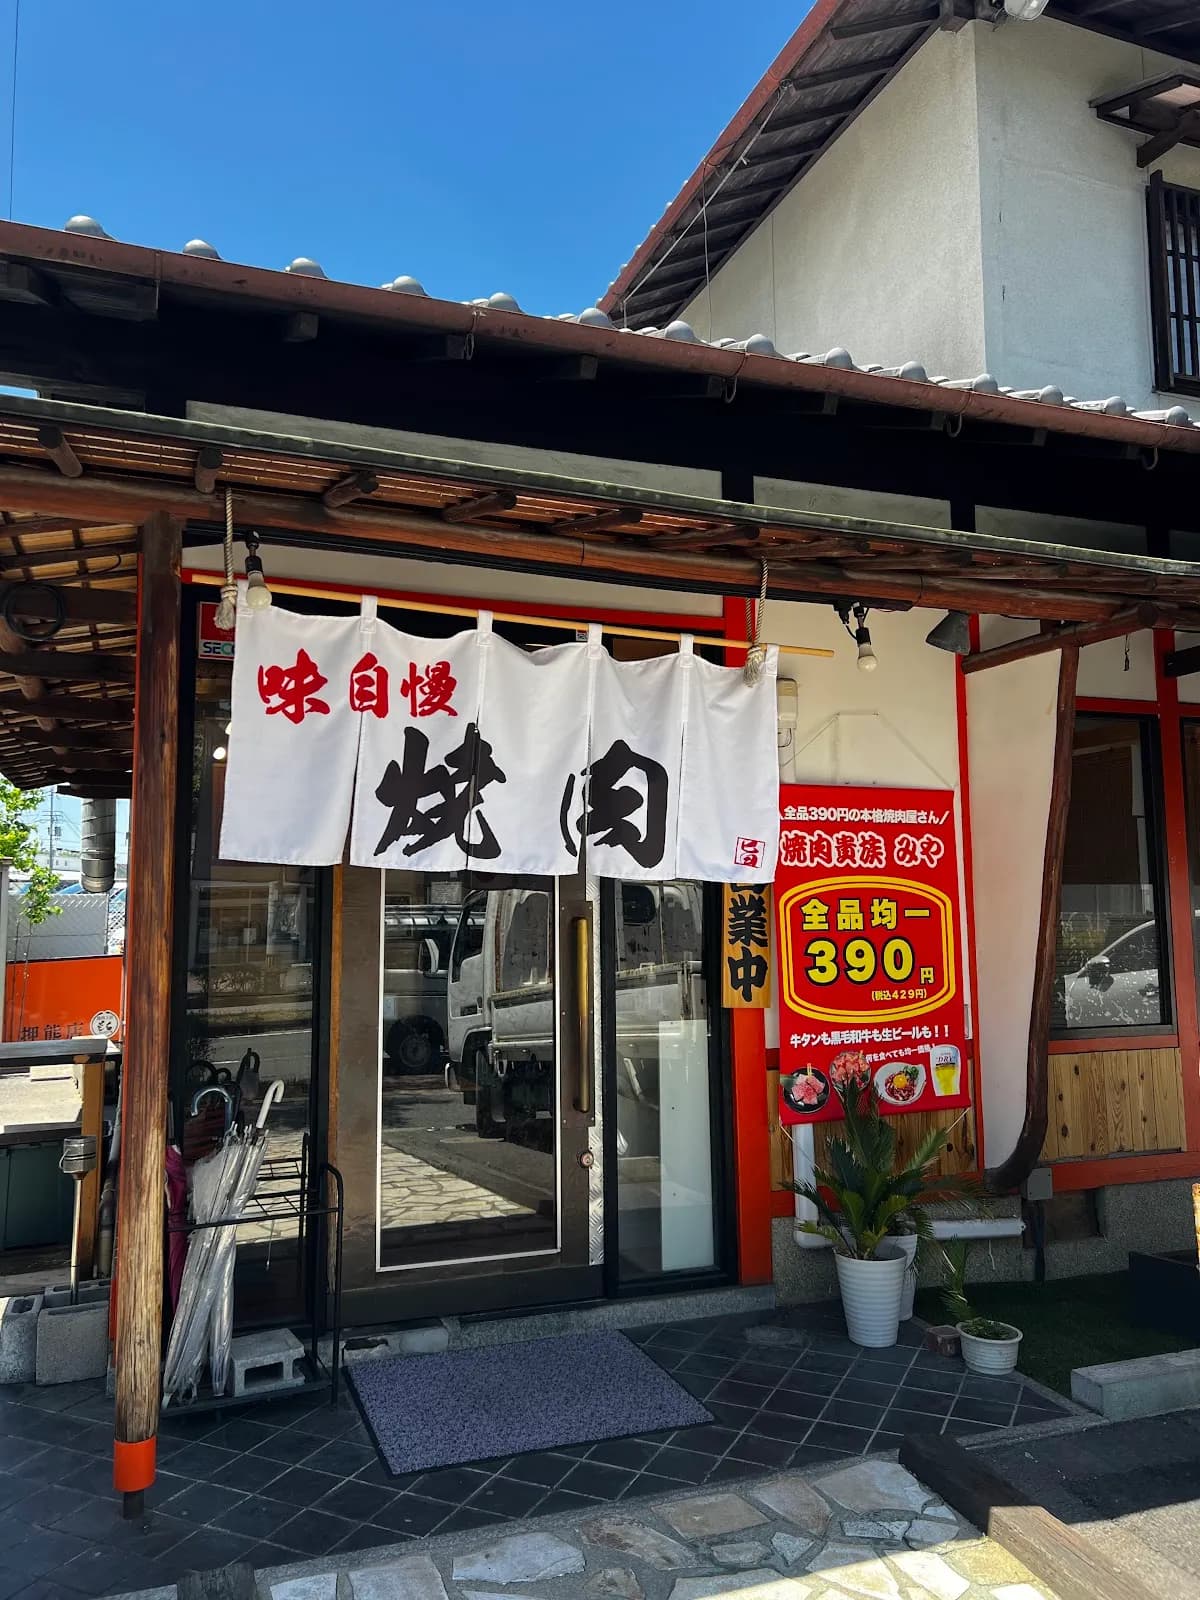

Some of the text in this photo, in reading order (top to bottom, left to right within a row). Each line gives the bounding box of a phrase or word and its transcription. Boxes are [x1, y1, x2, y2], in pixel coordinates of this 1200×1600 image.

[203, 641, 235, 655] SEC
[257, 648, 459, 724] 味自慢
[374, 722, 669, 869] 焼肉
[779, 829, 945, 868] 焼肉貴族 みや
[801, 898, 930, 931] 全品均一
[728, 883, 769, 1002] 業中
[790, 1024, 949, 1048] 牛タンも黒毛和牛も生ビールも！！
